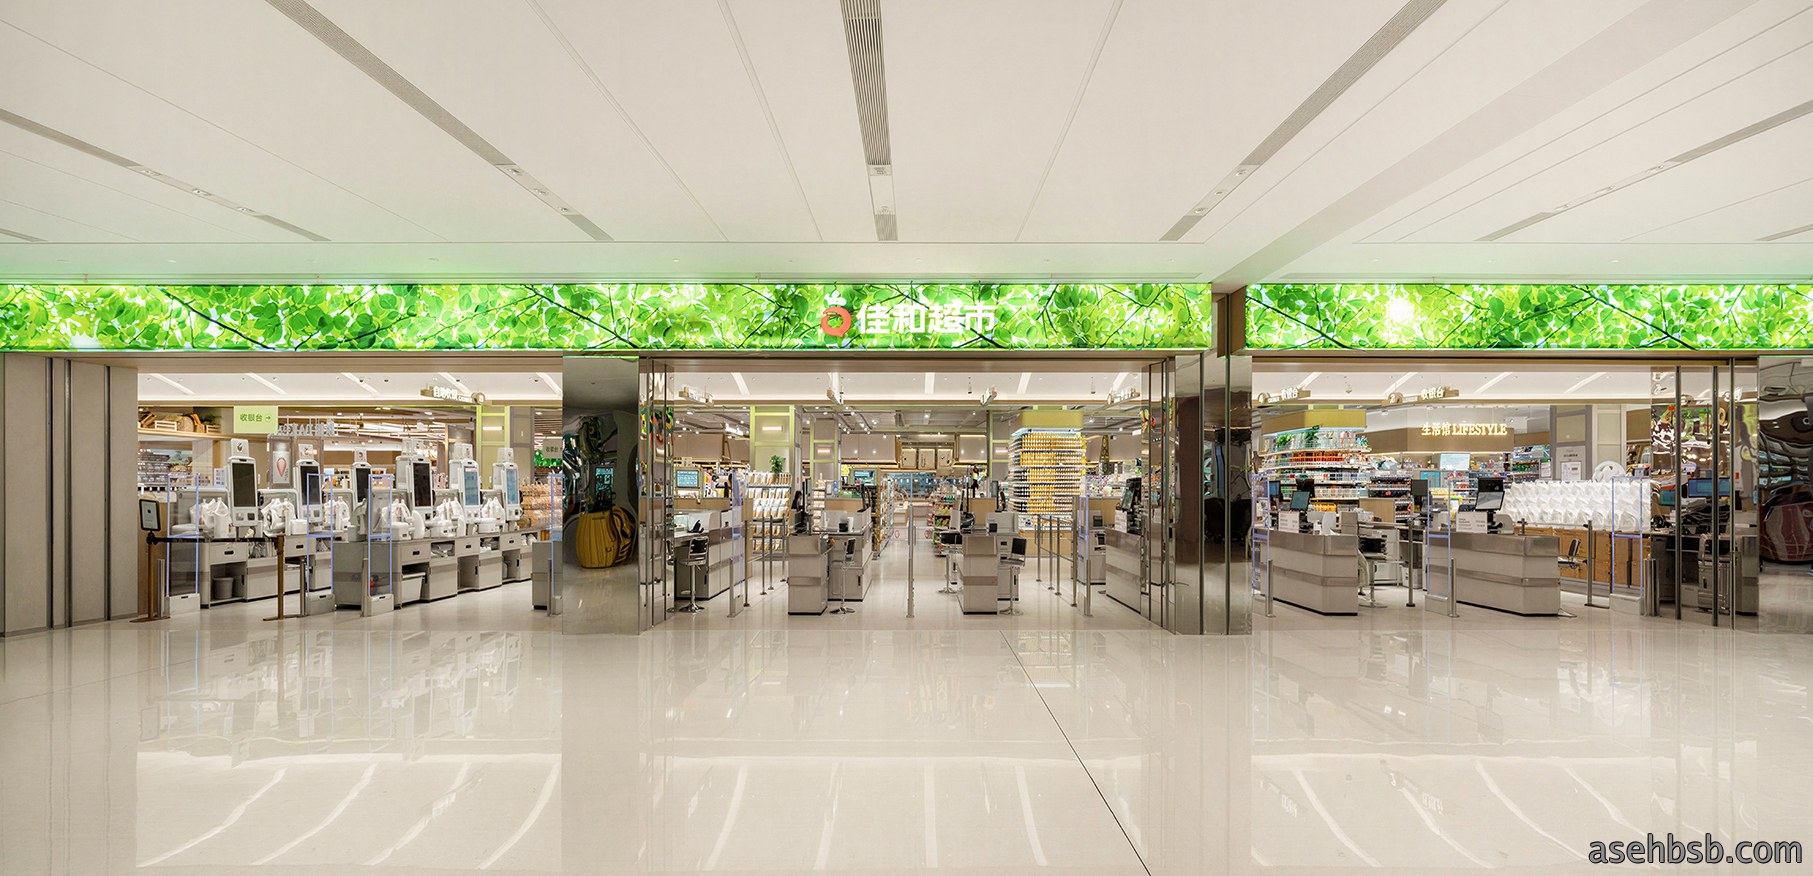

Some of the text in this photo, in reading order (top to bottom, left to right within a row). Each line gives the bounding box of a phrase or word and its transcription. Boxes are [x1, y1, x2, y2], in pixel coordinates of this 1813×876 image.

[857, 302, 997, 334] 佳和超市
[240, 413, 263, 422] 收银台
[1421, 422, 1508, 436] 生活馆 LIFESTYLE
